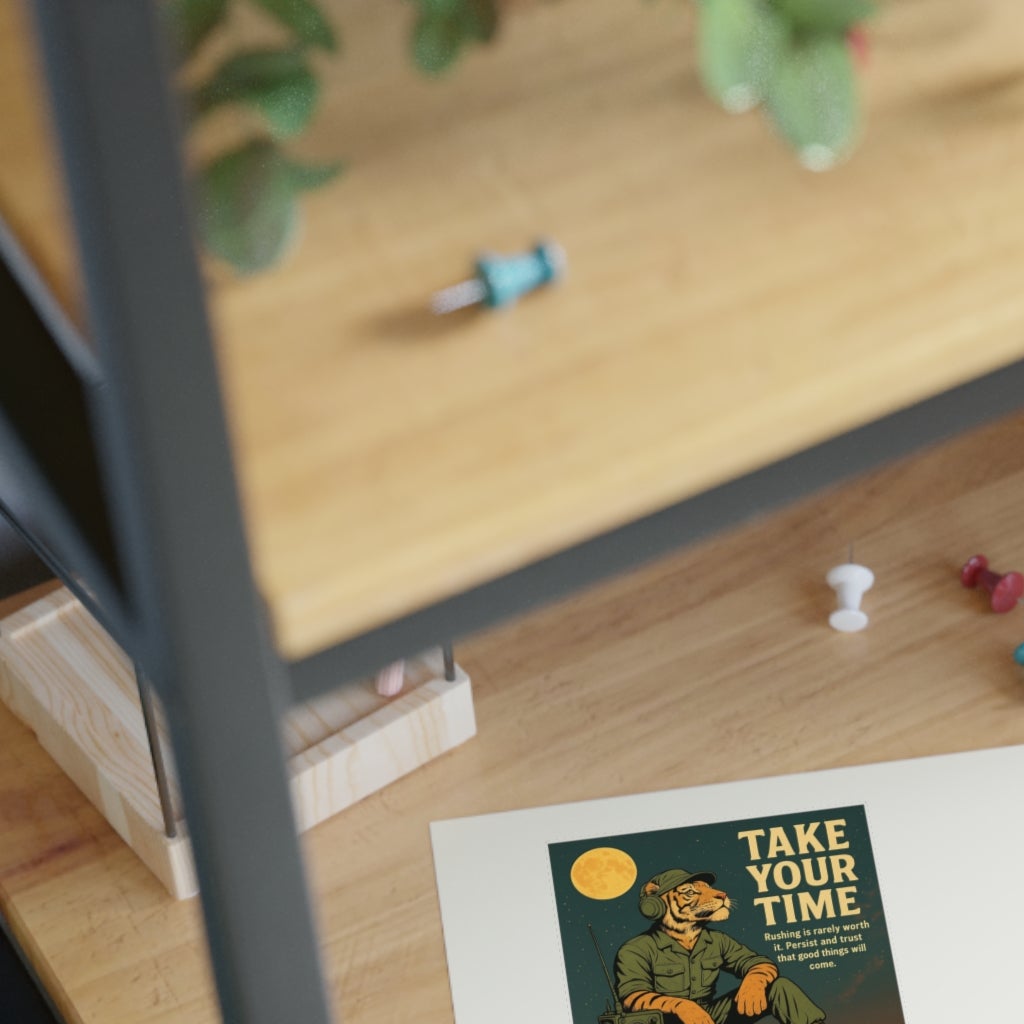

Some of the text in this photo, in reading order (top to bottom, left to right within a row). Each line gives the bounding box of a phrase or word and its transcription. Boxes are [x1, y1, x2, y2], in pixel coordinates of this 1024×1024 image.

[738, 819, 849, 860] TAKE
[745, 854, 859, 893] YOUR
[753, 886, 861, 926] TIME
[764, 921, 870, 941] Rushing is rarely worth
[786, 940, 818, 949] Persist
[821, 936, 837, 945] and
[840, 934, 862, 942] trust
[777, 944, 867, 962] that good things will
[809, 961, 837, 970] come.
